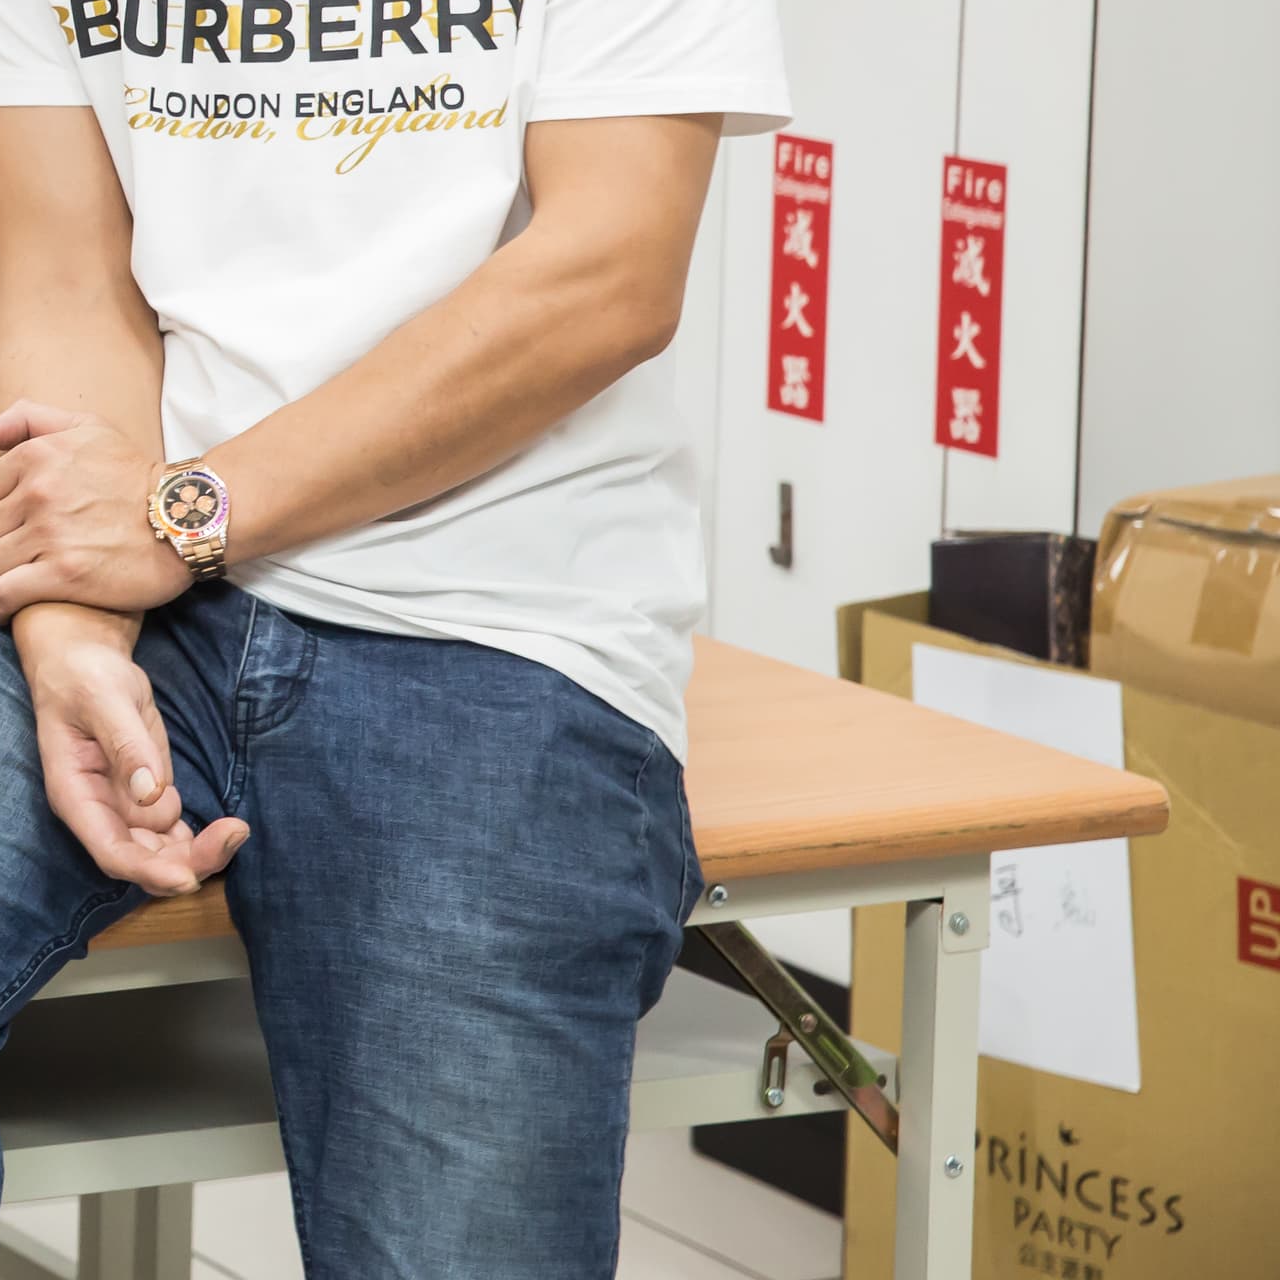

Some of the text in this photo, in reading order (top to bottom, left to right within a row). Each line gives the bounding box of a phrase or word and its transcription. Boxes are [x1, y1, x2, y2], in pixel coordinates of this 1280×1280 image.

[149, 86, 281, 119] LONDON
[778, 142, 831, 180] Fire
[947, 165, 1003, 203] Fire
[1014, 1196, 1122, 1261] PARTY
